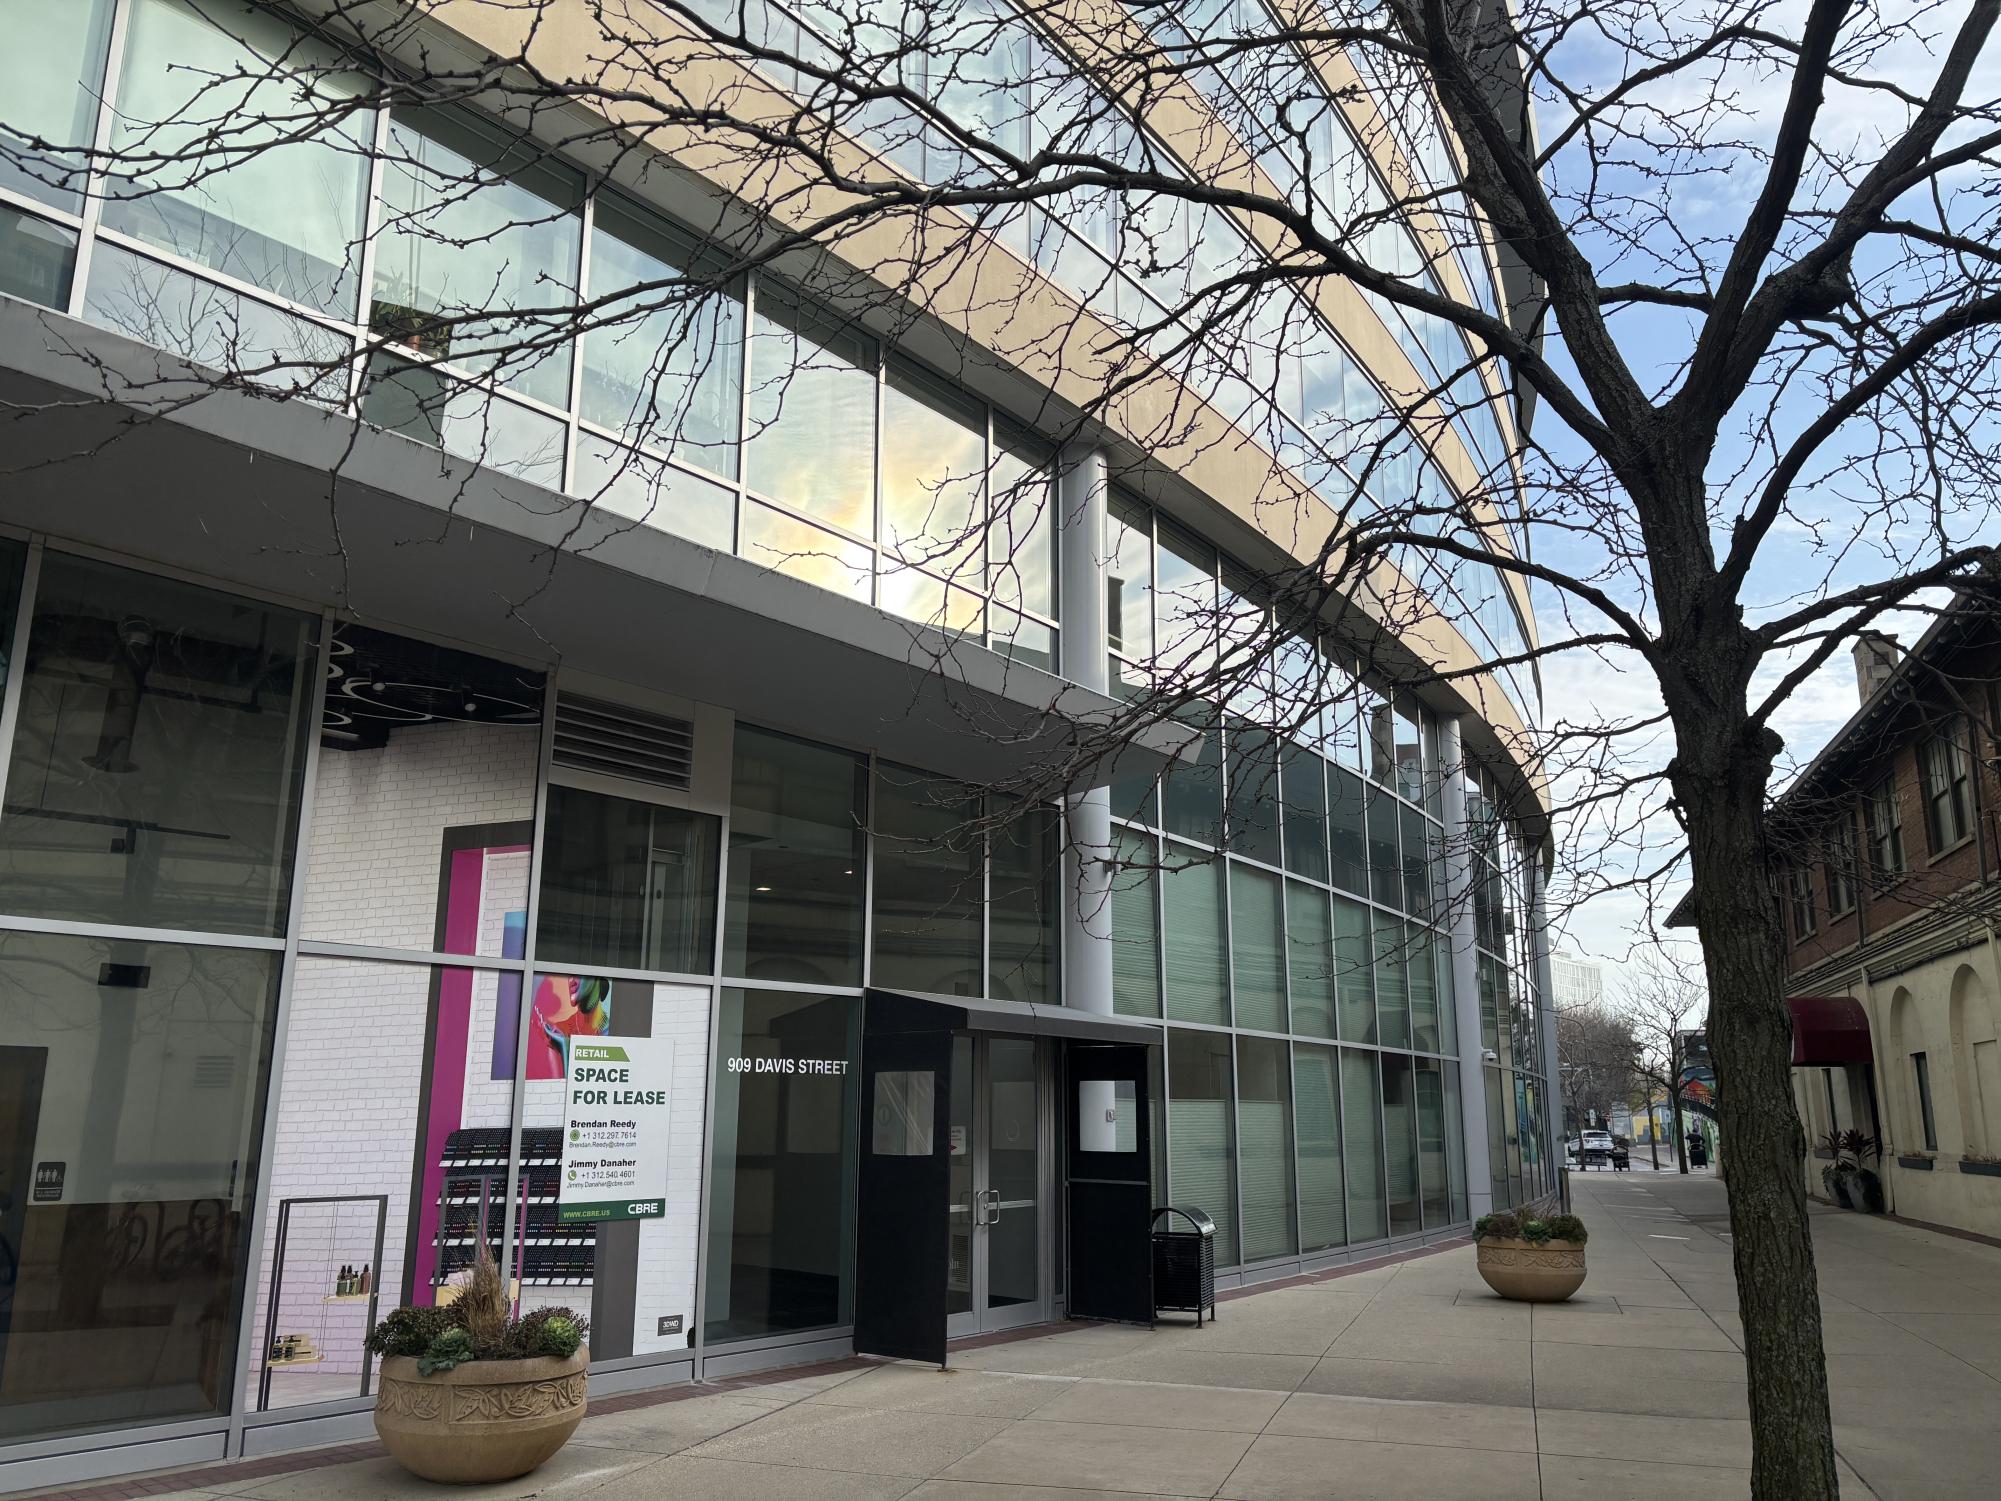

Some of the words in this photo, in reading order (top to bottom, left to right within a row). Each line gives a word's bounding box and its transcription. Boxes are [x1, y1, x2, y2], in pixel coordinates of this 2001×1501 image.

[576, 1049, 609, 1058] RETAIL
[727, 1058, 751, 1072] 909
[755, 1058, 795, 1073] DAVIS
[798, 1060, 848, 1075] STREET
[574, 1068, 629, 1082] SPACE
[573, 1090, 607, 1105] FOR
[613, 1091, 665, 1105] LEASE
[570, 1120, 607, 1128] Brendan
[610, 1120, 636, 1129] Reedy
[568, 1160, 598, 1169] Jimmy
[600, 1159, 636, 1167] Danaher
[563, 1209, 610, 1218] WWW.CBRE.US
[627, 1203, 658, 1214] CBRE
